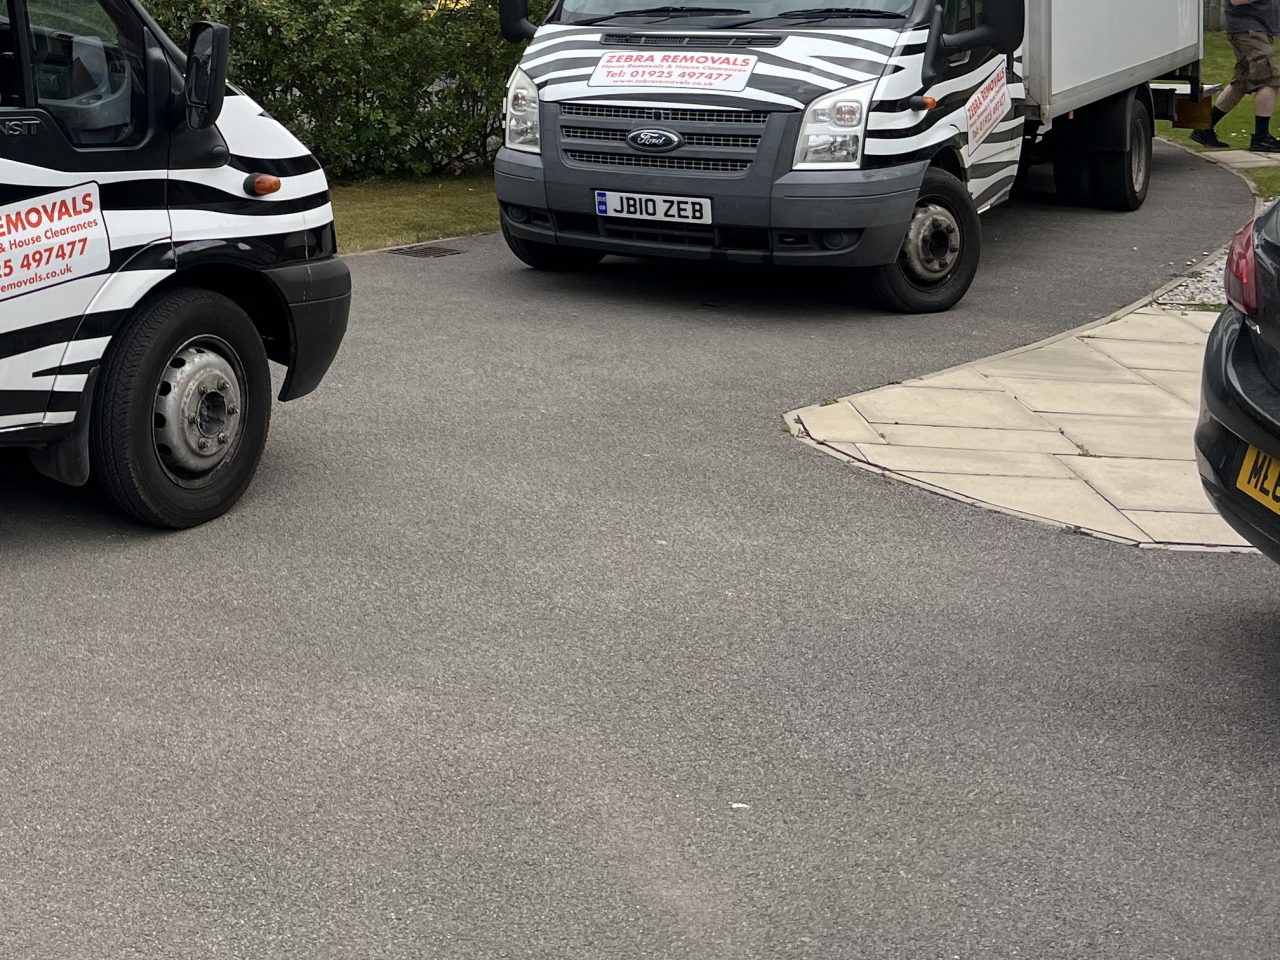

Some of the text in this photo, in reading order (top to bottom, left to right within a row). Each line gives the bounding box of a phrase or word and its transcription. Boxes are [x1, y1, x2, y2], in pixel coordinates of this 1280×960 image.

[605, 54, 750, 67] ZEBRA REMOVALS
[606, 70, 733, 81] Tel: 01925 497477
[637, 132, 664, 145] Ford
[663, 200, 704, 220] ZEB
[9, 234, 42, 251] House
[44, 218, 98, 240] Clearances
[20, 237, 88, 270] 497477
